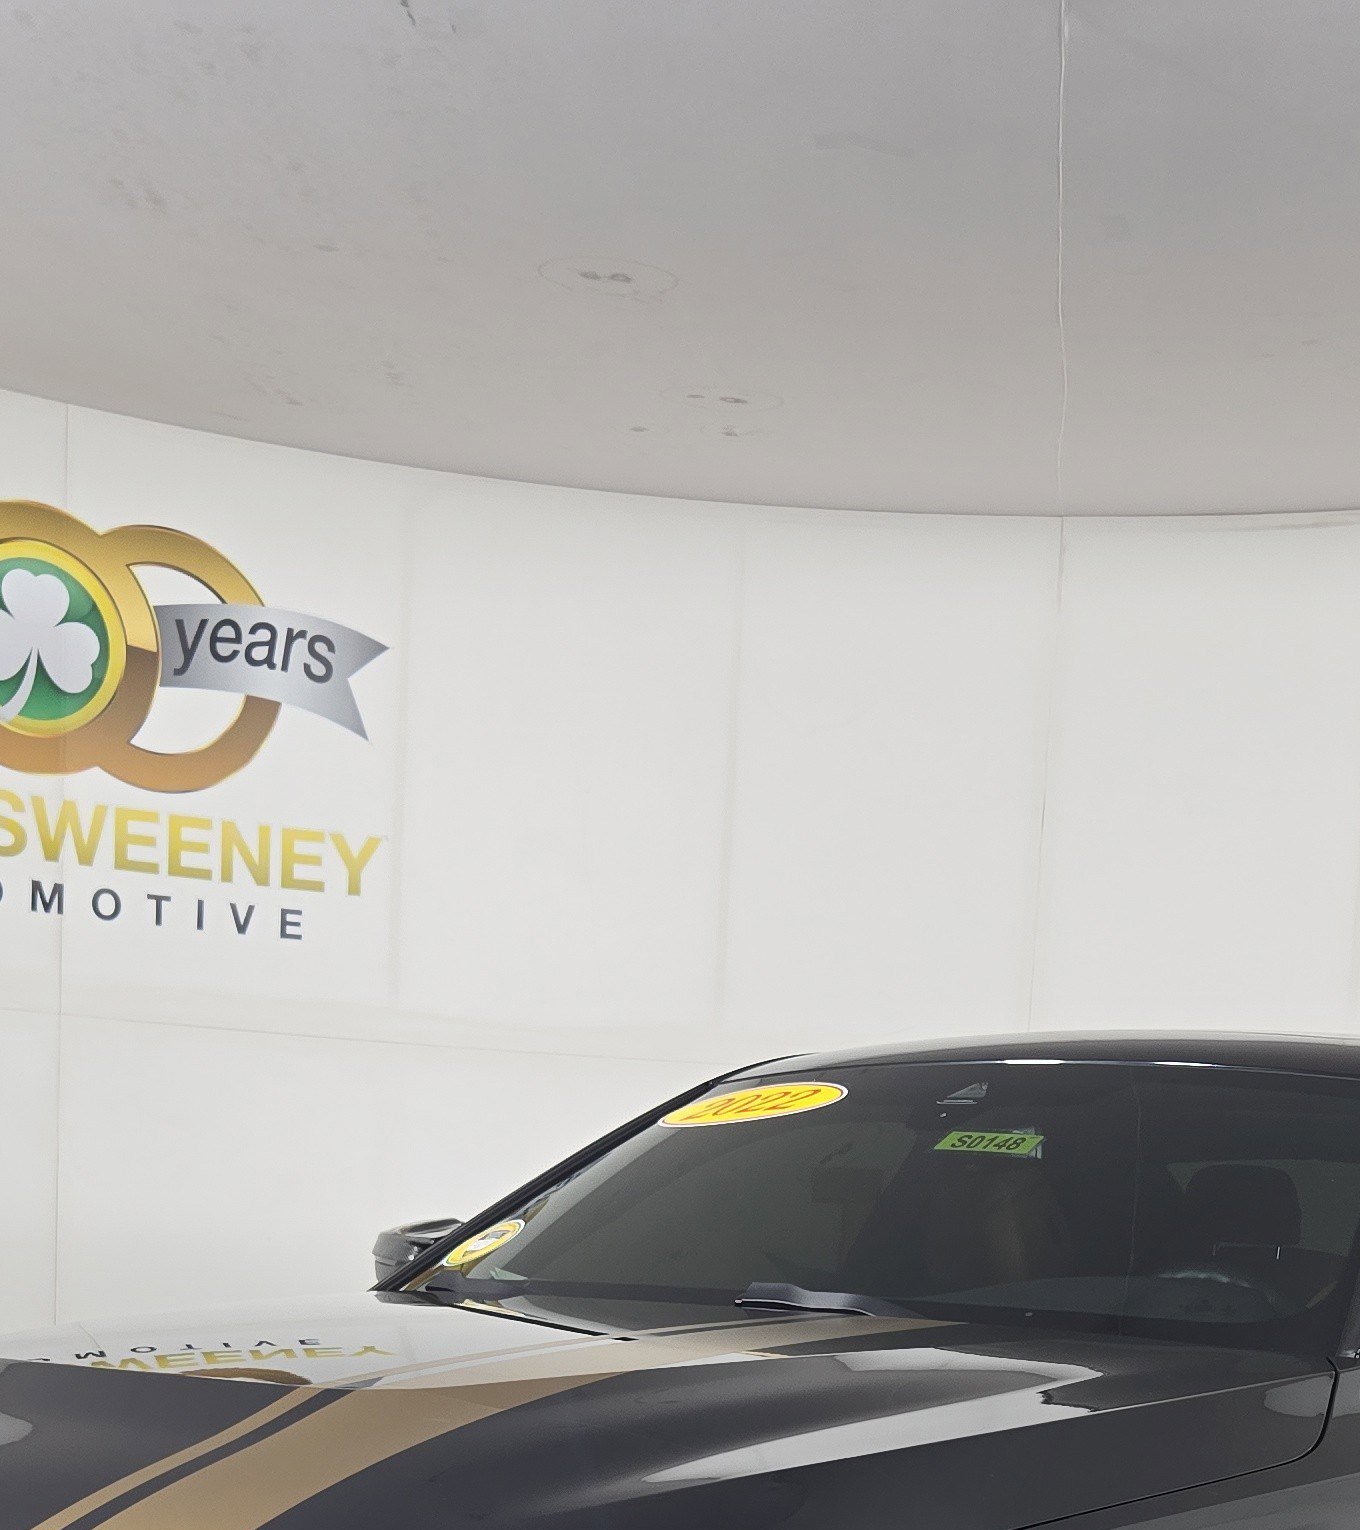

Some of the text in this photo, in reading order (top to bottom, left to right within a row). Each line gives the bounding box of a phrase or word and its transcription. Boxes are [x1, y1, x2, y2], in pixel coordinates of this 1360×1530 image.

[173, 616, 337, 683] years
[679, 1088, 821, 1121] 2022
[950, 1134, 1027, 1151] S0148
